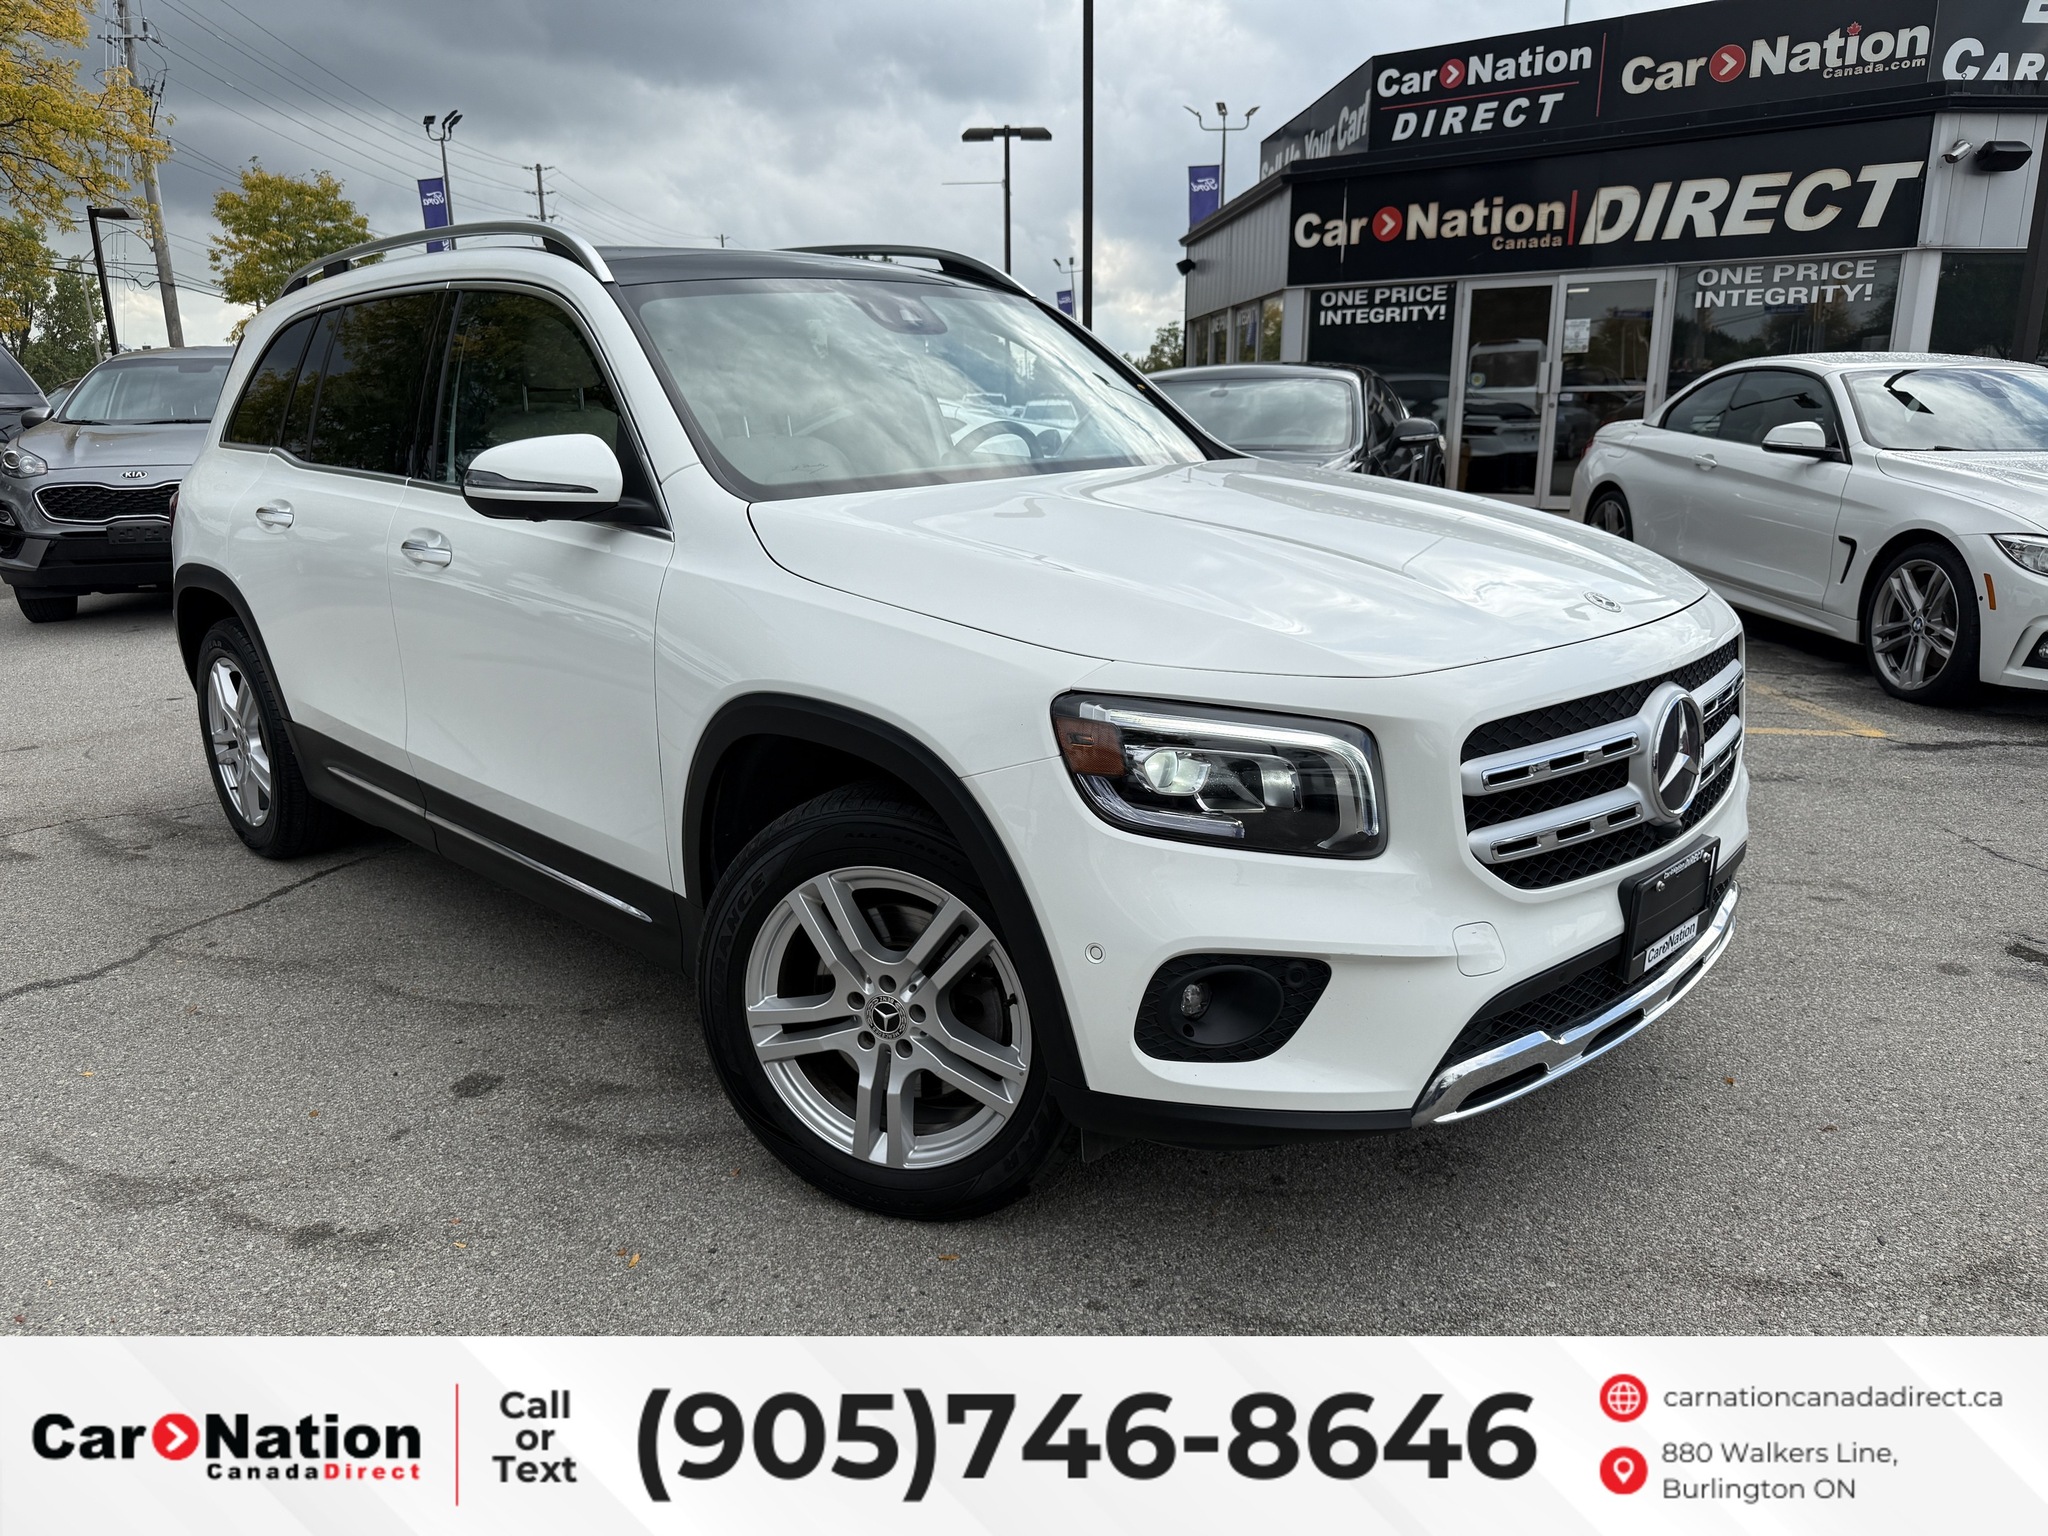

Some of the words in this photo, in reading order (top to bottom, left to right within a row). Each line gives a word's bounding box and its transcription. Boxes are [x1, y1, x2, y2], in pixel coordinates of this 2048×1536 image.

[1822, 57, 1926, 79] Canada.com
[1942, 37, 2048, 80] CAR
[1304, 125, 1335, 159] Your
[1337, 88, 1371, 151] Car!
[1391, 92, 1565, 142] DIRECT
[1578, 160, 1925, 246] DIRECT
[1492, 233, 1563, 250] Canada
[1697, 265, 1764, 286] ONE
[1772, 259, 1877, 282] PRICE
[1320, 289, 1369, 307] ONE
[1374, 284, 1448, 304] PRICE
[1694, 283, 1873, 308] INTEGRITY!
[1319, 304, 1446, 326] INTEGRITY!
